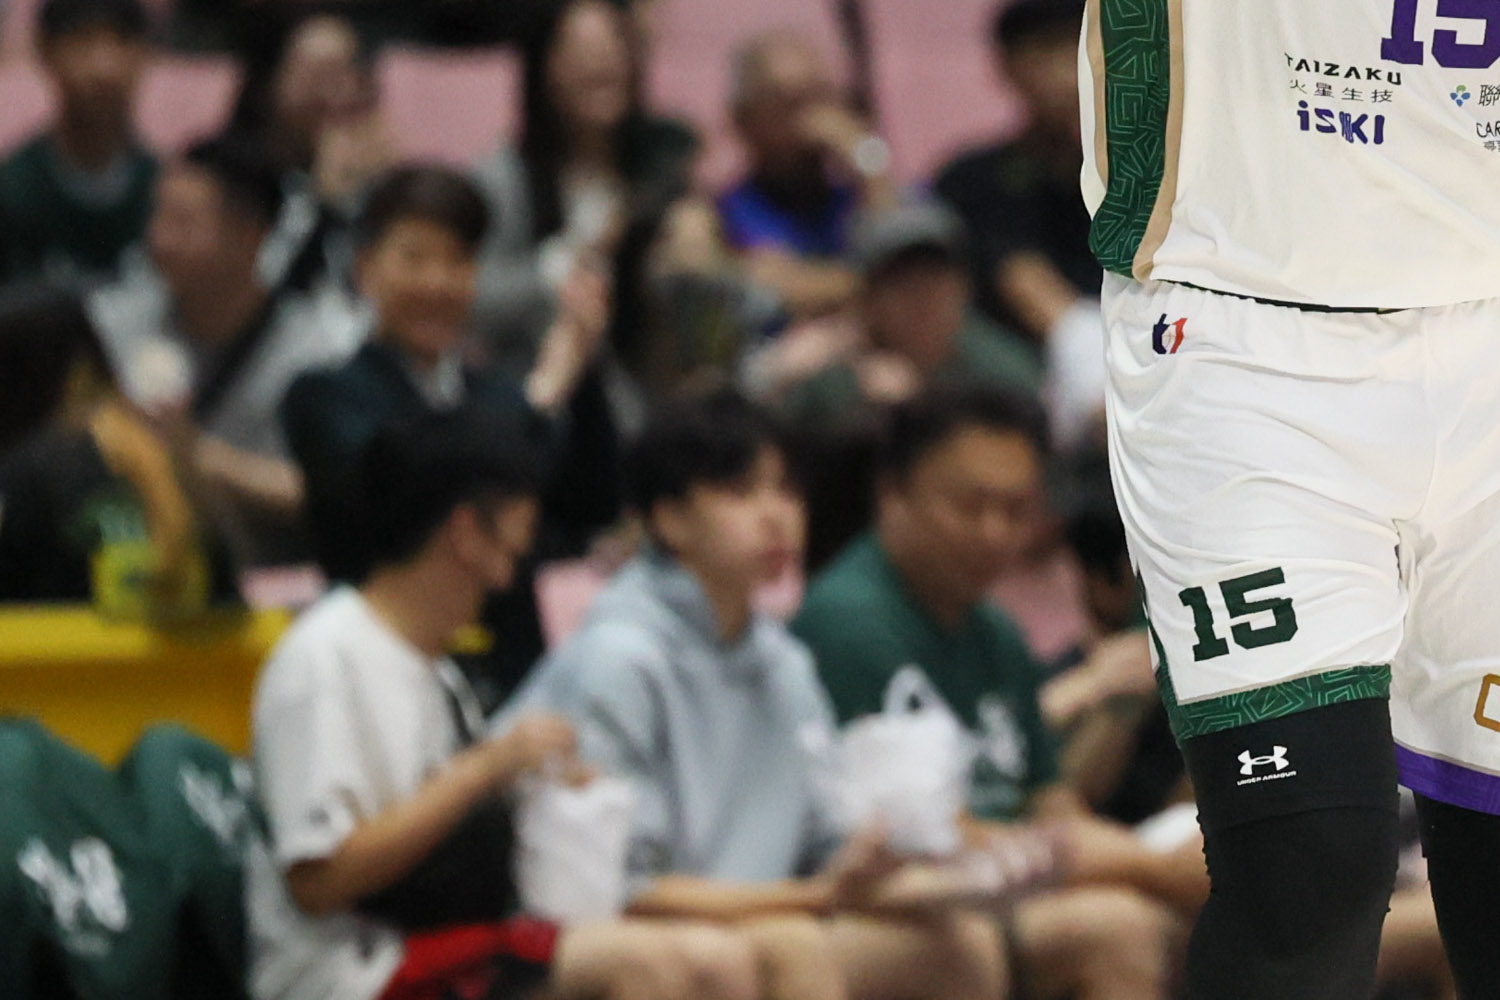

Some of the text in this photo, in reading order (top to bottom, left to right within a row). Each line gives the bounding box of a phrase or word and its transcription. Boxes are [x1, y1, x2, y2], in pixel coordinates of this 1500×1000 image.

[1284, 52, 1402, 86] TAIZAKU
[1290, 78, 1394, 103] 火星生技
[1178, 566, 1298, 662] 15
[1237, 771, 1297, 786] UNDER ARMOUR
